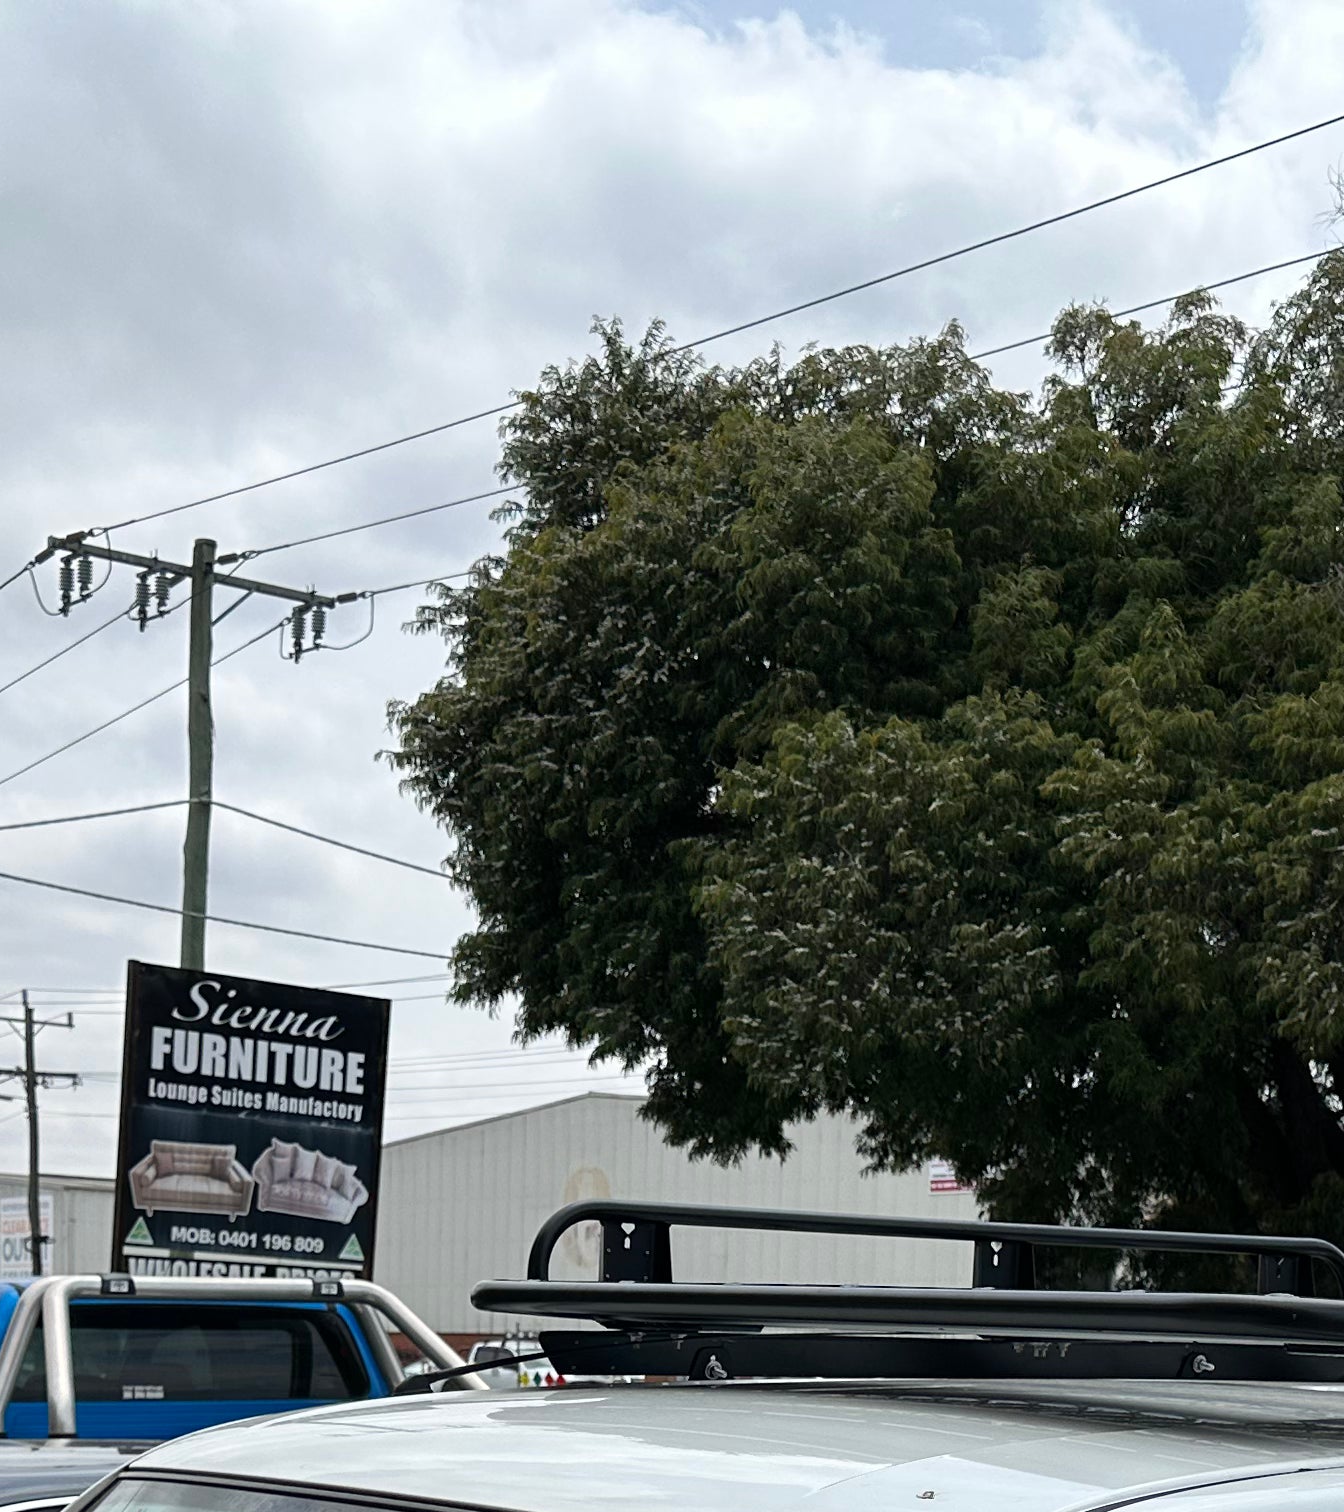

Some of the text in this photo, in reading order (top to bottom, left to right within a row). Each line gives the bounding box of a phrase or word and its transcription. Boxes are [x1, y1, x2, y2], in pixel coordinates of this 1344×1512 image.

[171, 980, 345, 1041] Sienna
[150, 1026, 366, 1095] FURNITURE
[148, 1077, 364, 1123] Lounge Suites Manufactory
[171, 1225, 325, 1254] MOB: 0401 196 809
